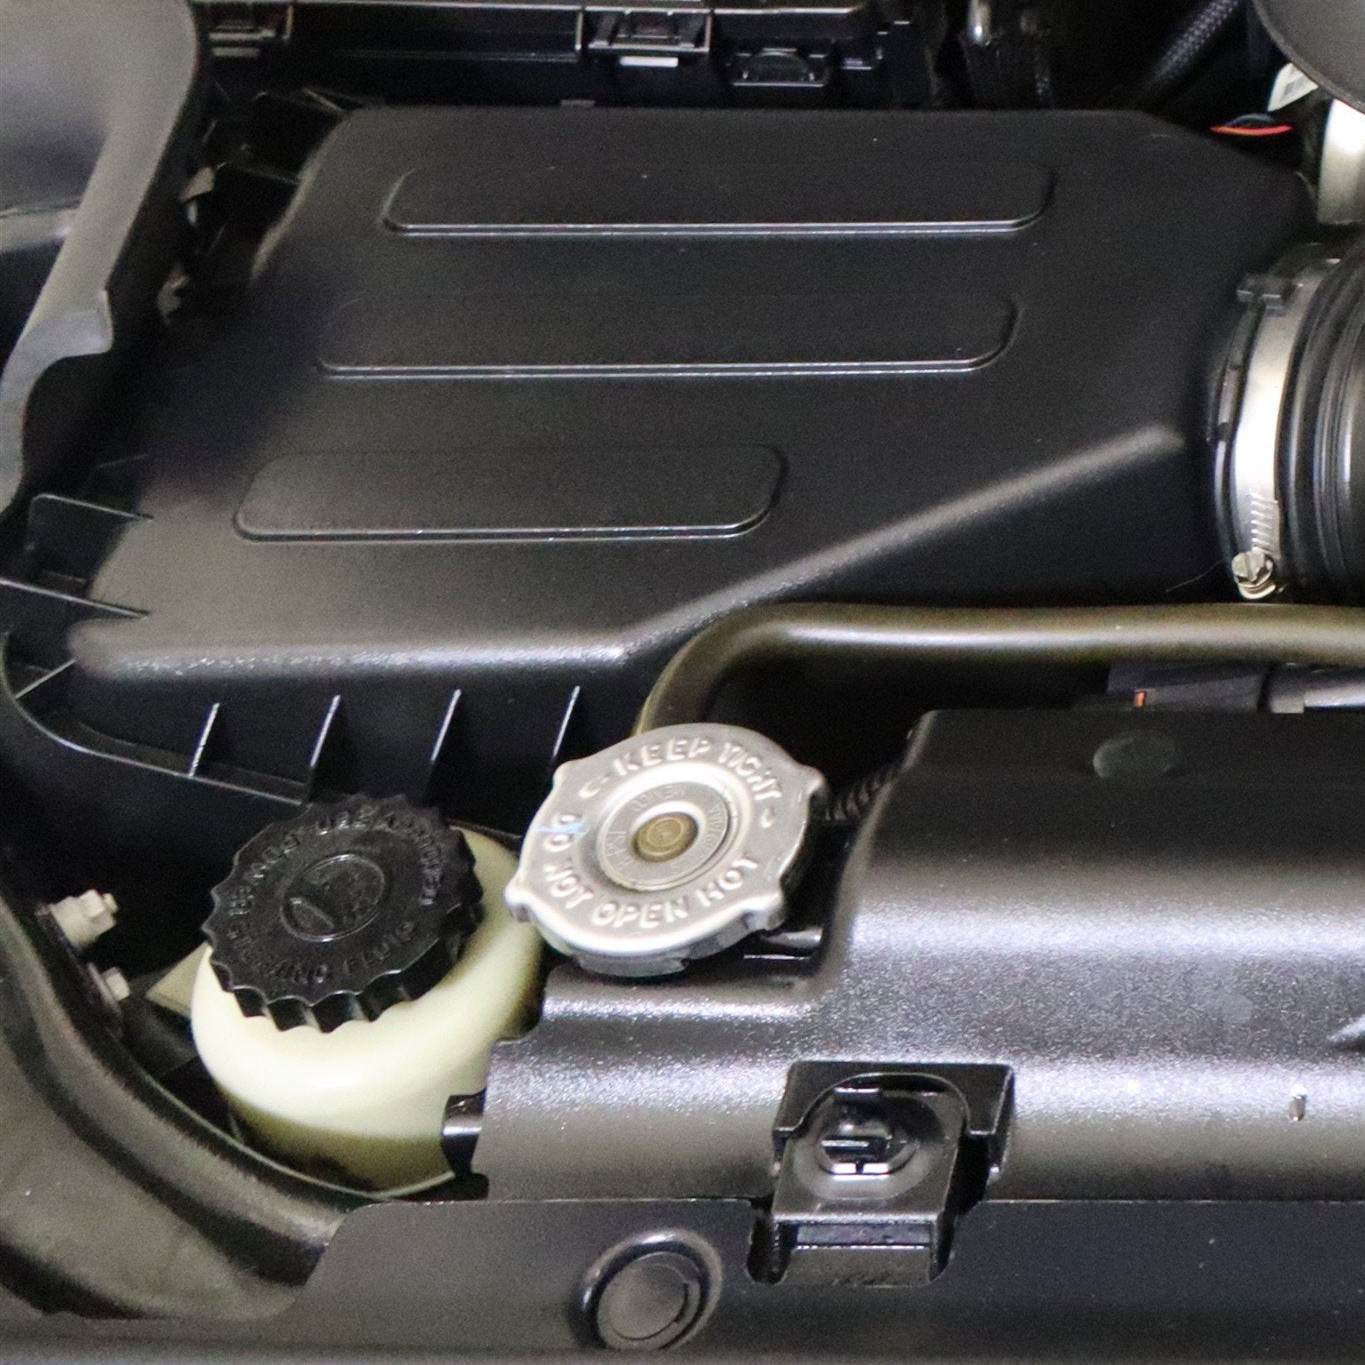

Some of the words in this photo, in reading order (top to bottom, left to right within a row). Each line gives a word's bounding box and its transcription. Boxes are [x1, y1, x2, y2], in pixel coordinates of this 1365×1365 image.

[612, 737, 712, 777] KEEP
[717, 741, 783, 802] TIGHT
[544, 863, 594, 909] NOT
[592, 895, 689, 929] OPEN
[695, 857, 759, 908] HOT
